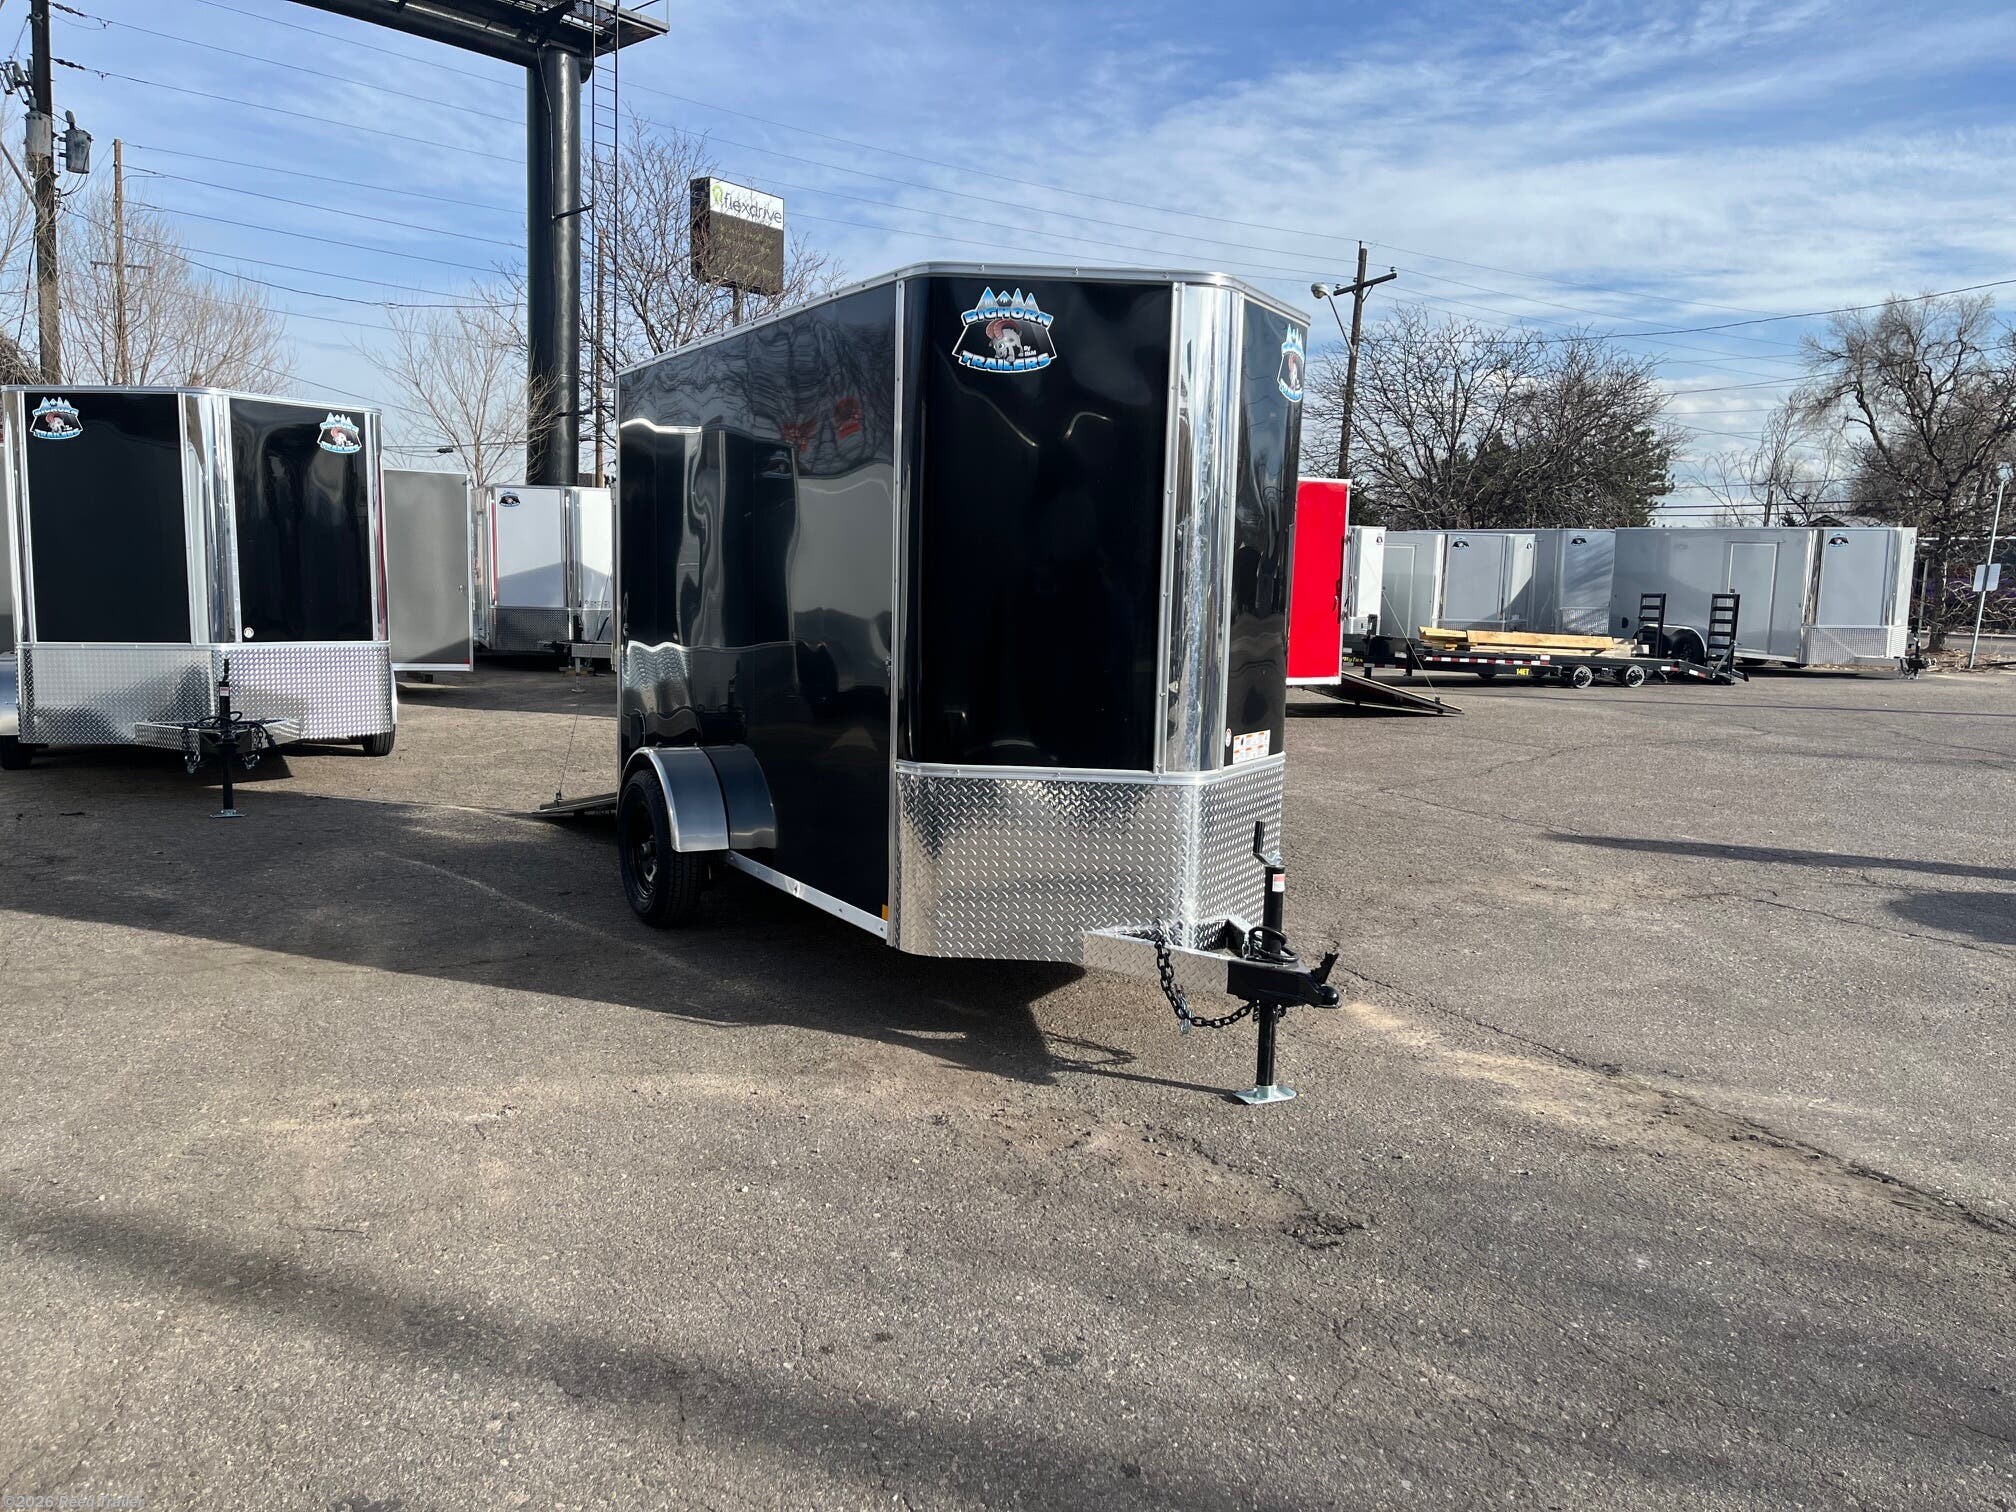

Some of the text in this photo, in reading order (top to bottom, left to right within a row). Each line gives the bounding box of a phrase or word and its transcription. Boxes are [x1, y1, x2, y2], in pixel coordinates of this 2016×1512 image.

[724, 193, 782, 224] flexdrive
[963, 306, 1053, 327] BIGHORN
[962, 350, 1051, 371] TRAILERS
